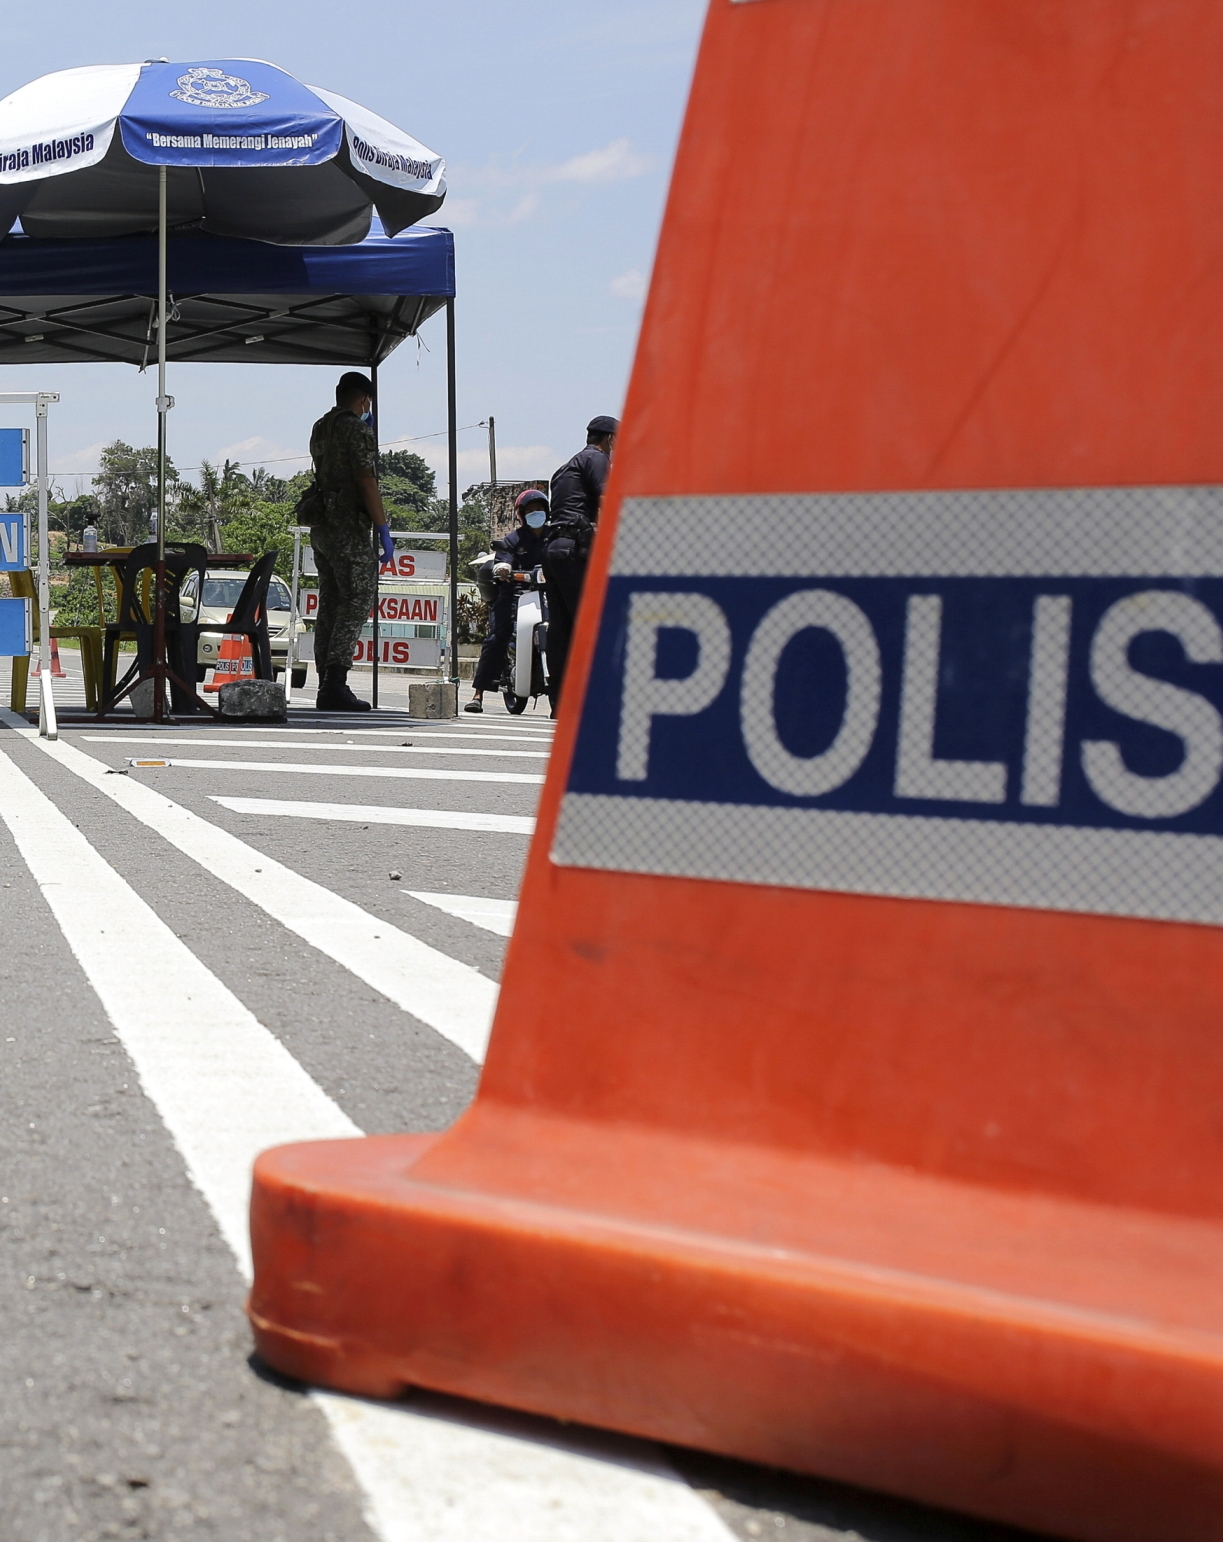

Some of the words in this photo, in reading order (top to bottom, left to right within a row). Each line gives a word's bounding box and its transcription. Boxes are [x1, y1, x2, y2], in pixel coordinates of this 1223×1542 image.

[32, 131, 94, 165] Malaysia
[203, 133, 265, 150] Memerangi
[353, 136, 375, 162] Polis
[397, 154, 433, 180] Malaysia
[379, 555, 416, 577] AS
[353, 640, 410, 664] OLIS
[216, 661, 230, 671] POLIS
[240, 660, 253, 671] OLIS
[616, 588, 1223, 819] POLIS
